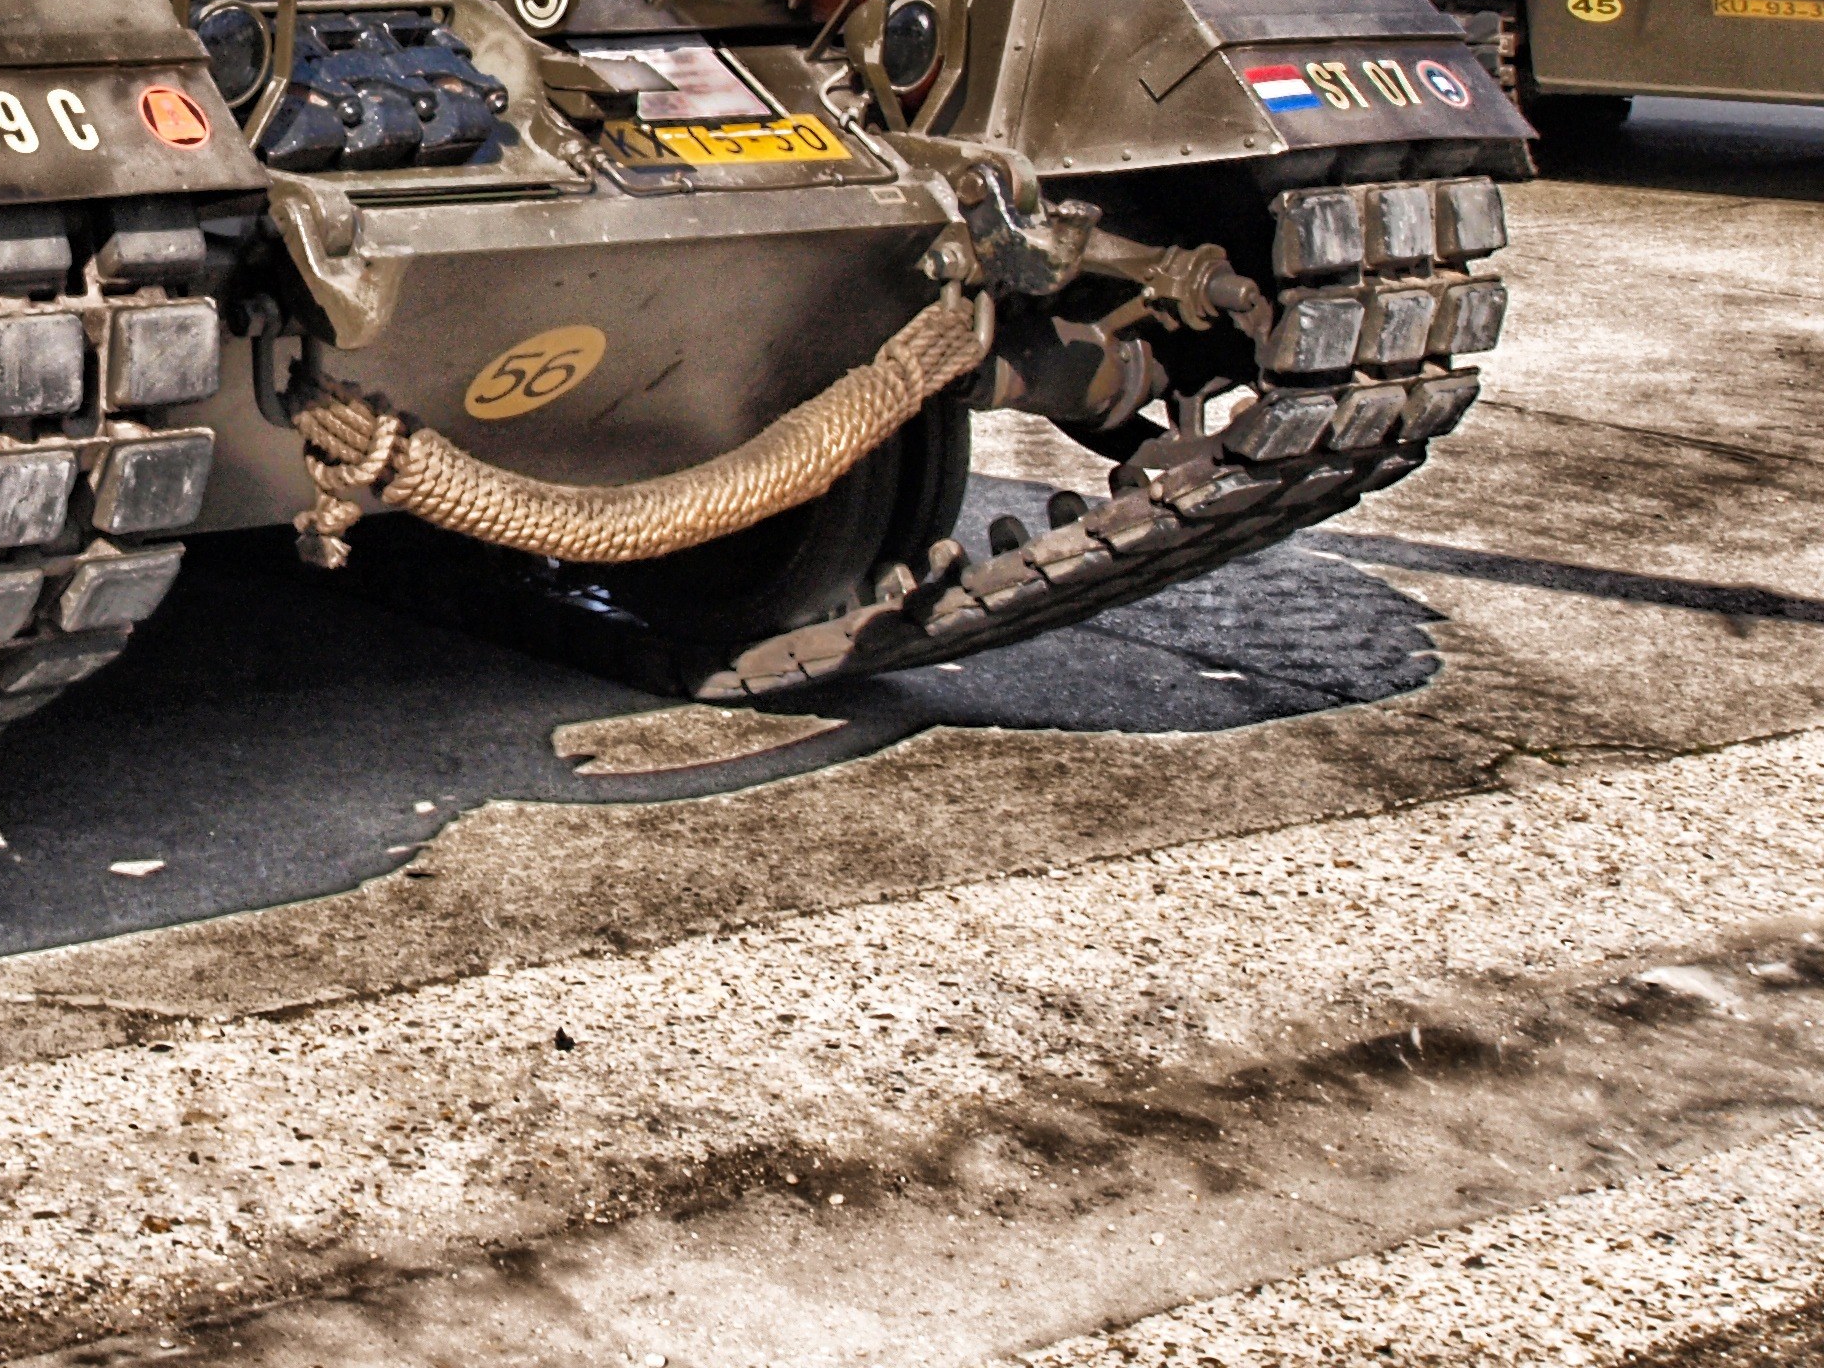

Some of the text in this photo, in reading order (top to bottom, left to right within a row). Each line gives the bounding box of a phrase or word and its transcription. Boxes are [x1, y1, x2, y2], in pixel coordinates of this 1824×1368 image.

[1306, 60, 1423, 110] ST 07
[47, 89, 99, 150] C
[474, 349, 582, 404] 56
